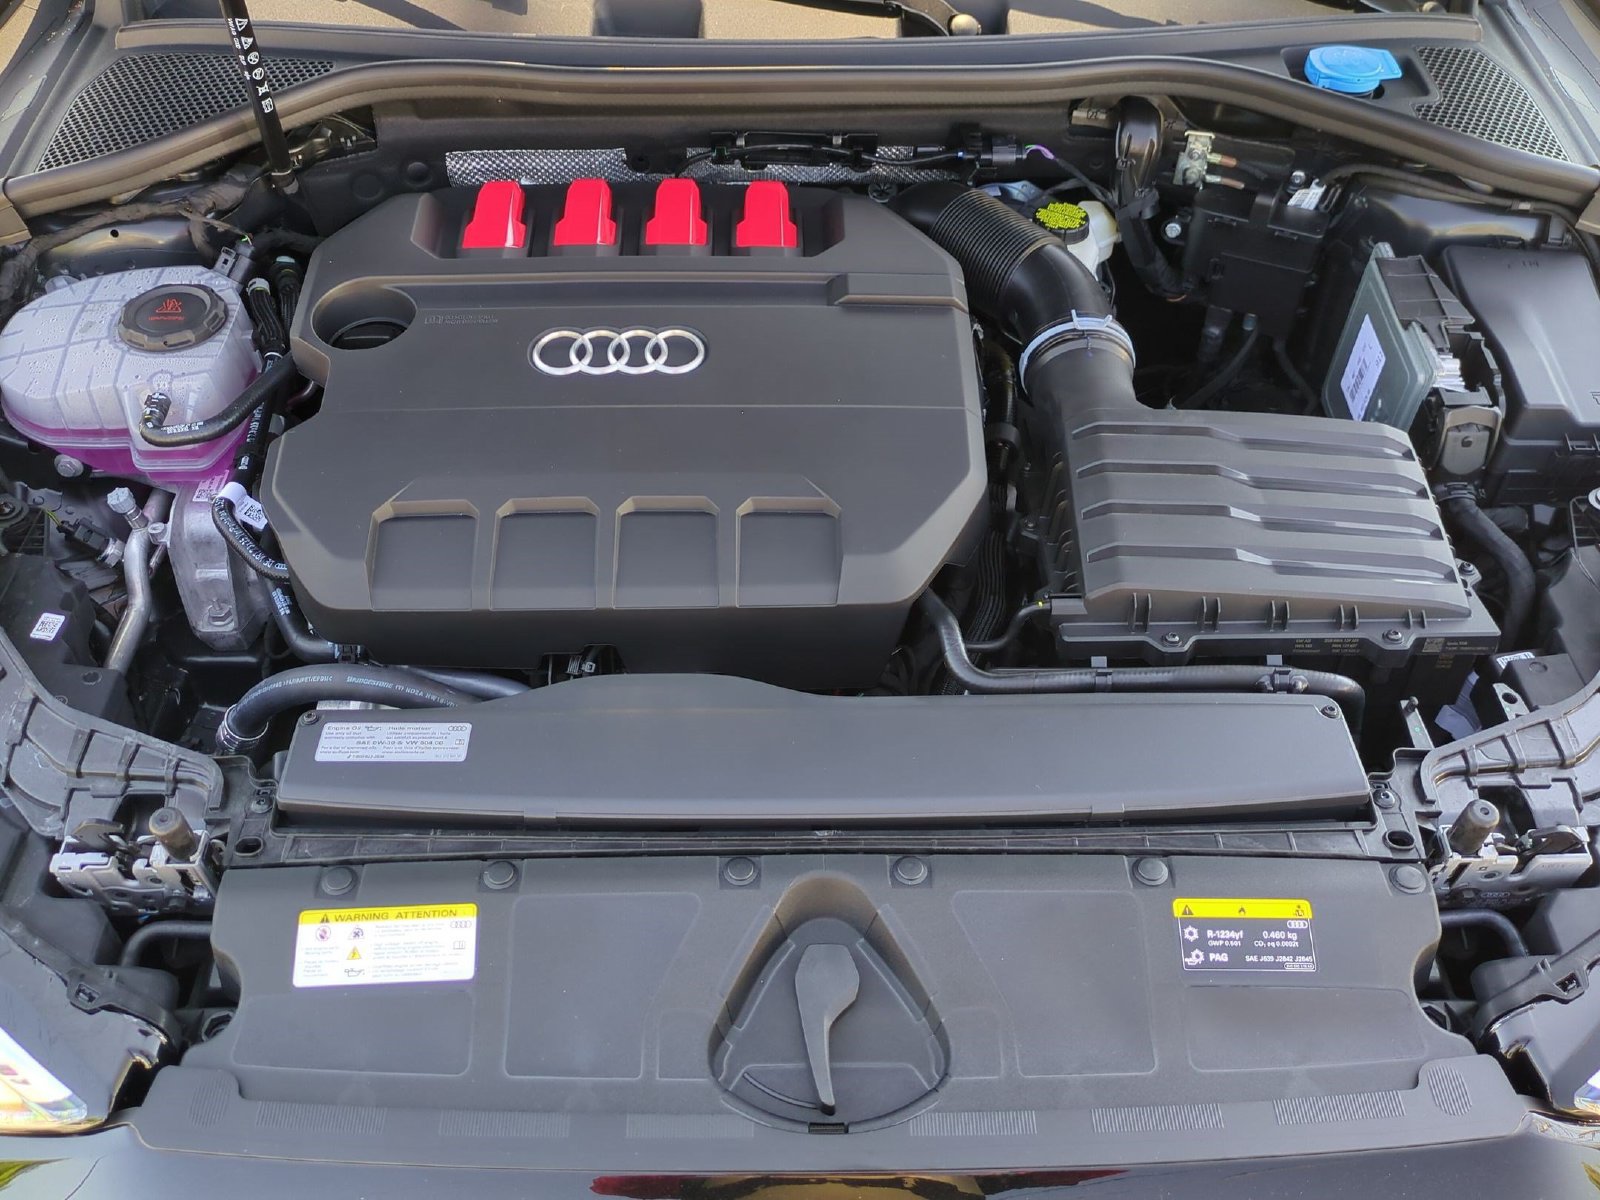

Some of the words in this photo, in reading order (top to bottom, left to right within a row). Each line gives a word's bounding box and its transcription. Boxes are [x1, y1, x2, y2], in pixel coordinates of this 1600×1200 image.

[334, 912, 389, 922] WARNING
[395, 909, 457, 920] ATTENTION
[1206, 930, 1244, 940] R-1234yf
[1287, 931, 1297, 940] kg
[1209, 953, 1229, 962] PAG
